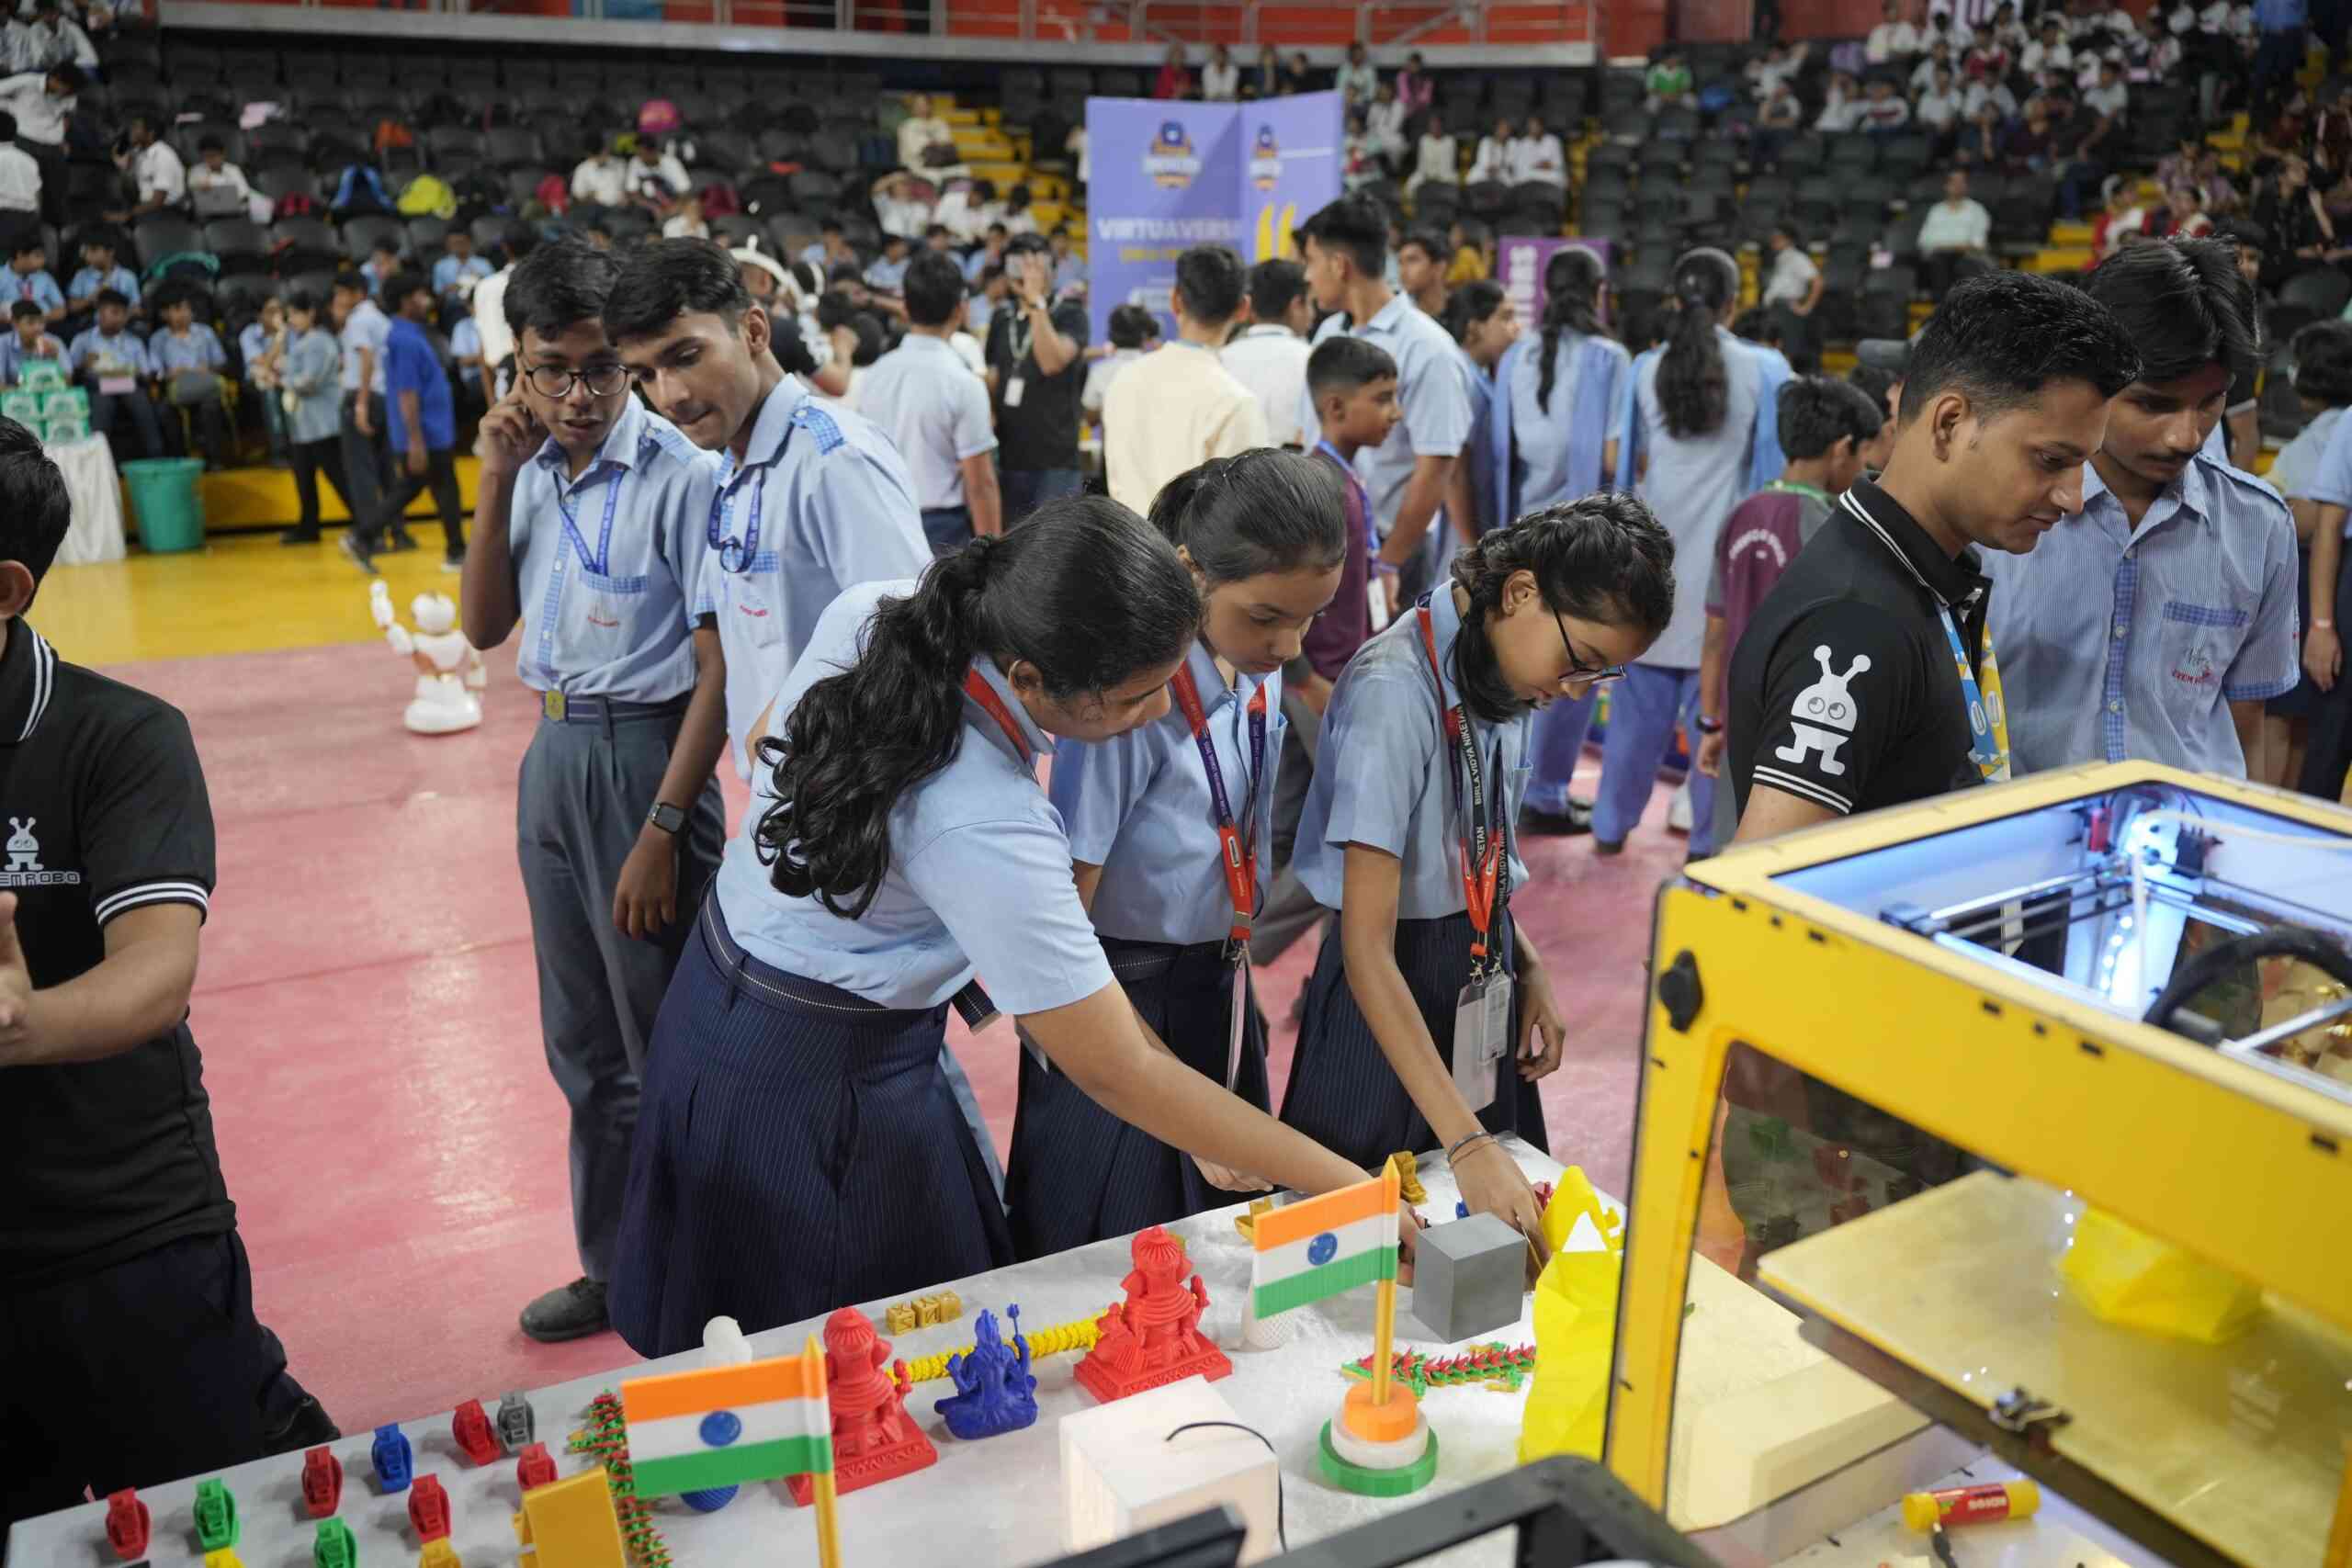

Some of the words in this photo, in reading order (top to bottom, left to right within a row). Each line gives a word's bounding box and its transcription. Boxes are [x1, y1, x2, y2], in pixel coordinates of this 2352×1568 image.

[1456, 705, 1473, 747] NIKETAN
[1467, 747, 1479, 777] VIDYA
[1473, 776, 1483, 806] BIRLA
[1498, 849, 1507, 876] VIDYA
